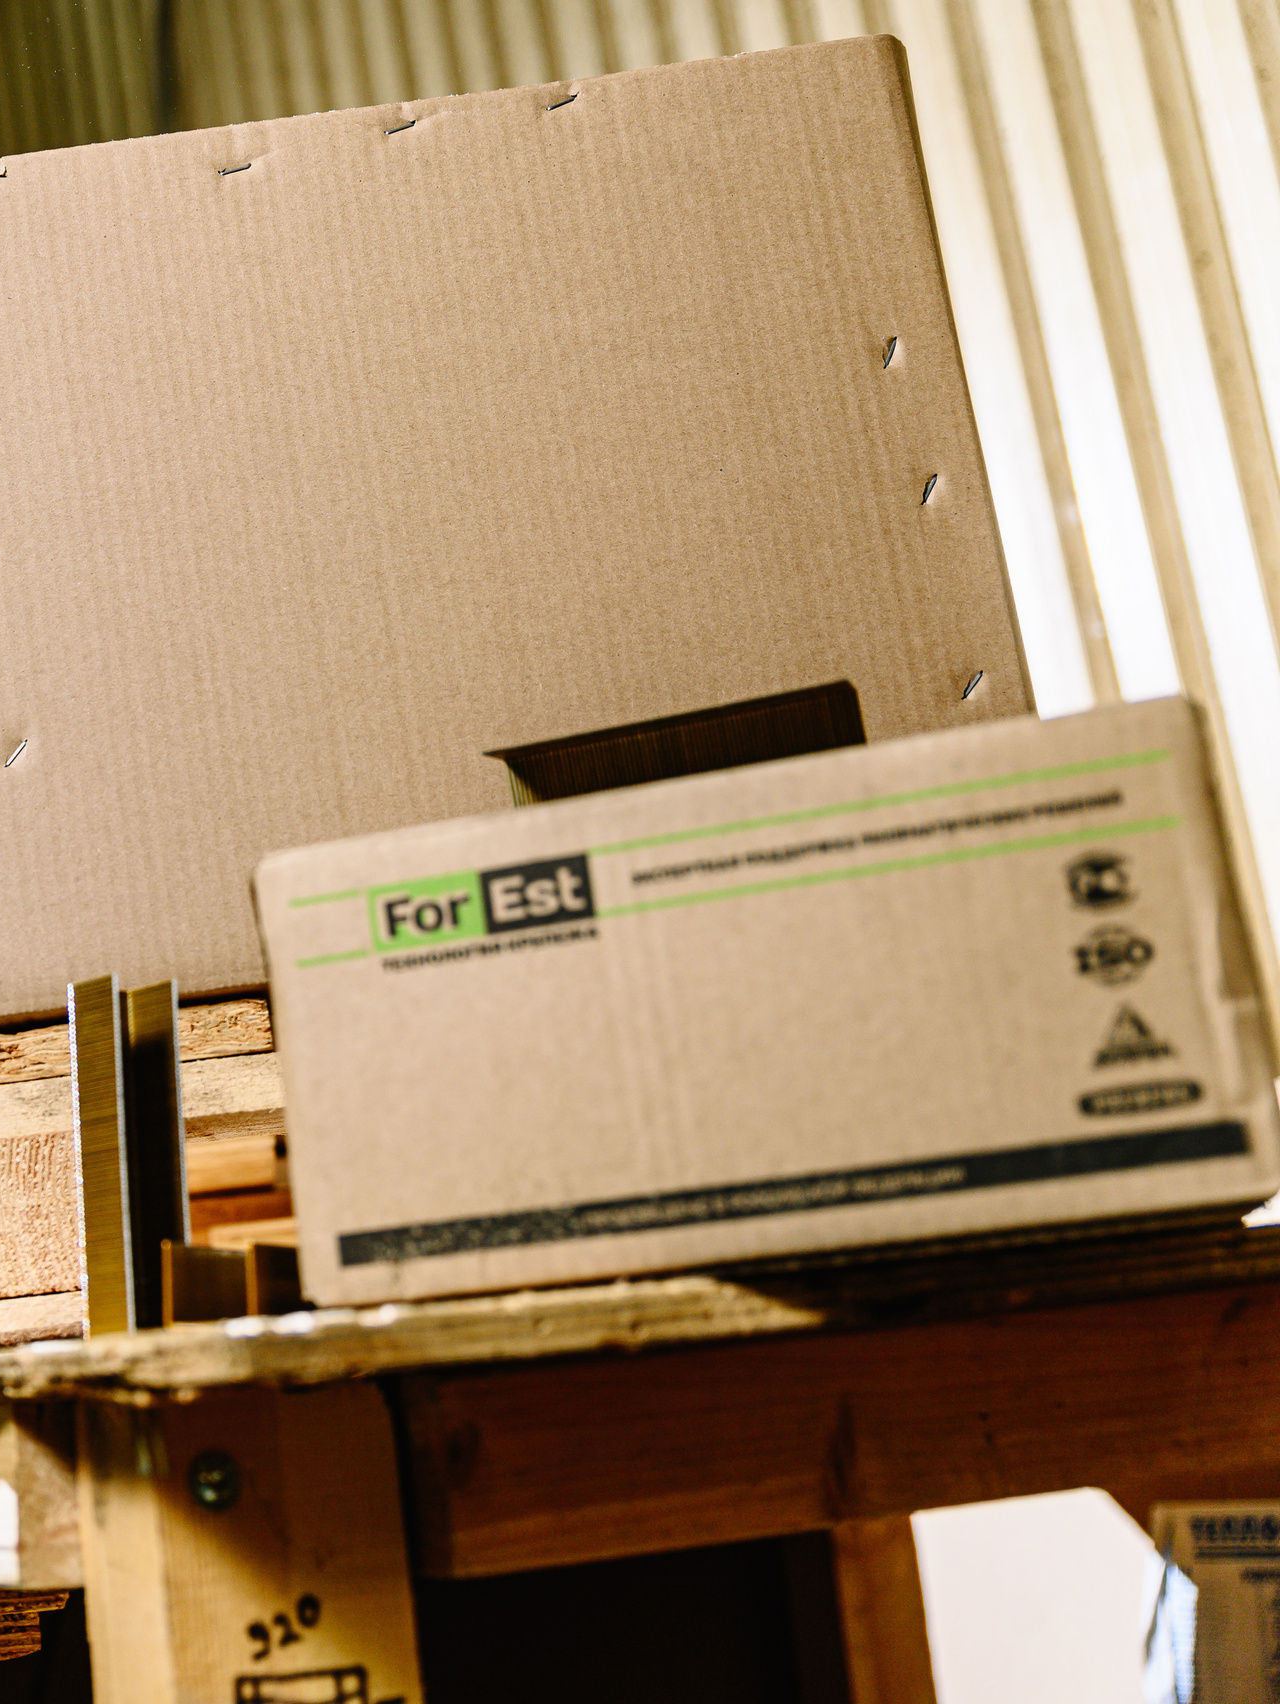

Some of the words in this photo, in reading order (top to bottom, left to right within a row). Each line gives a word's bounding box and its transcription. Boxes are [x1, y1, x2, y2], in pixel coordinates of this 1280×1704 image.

[381, 894, 469, 939] For
[489, 867, 586, 923] Est
[247, 1594, 321, 1661] 920
